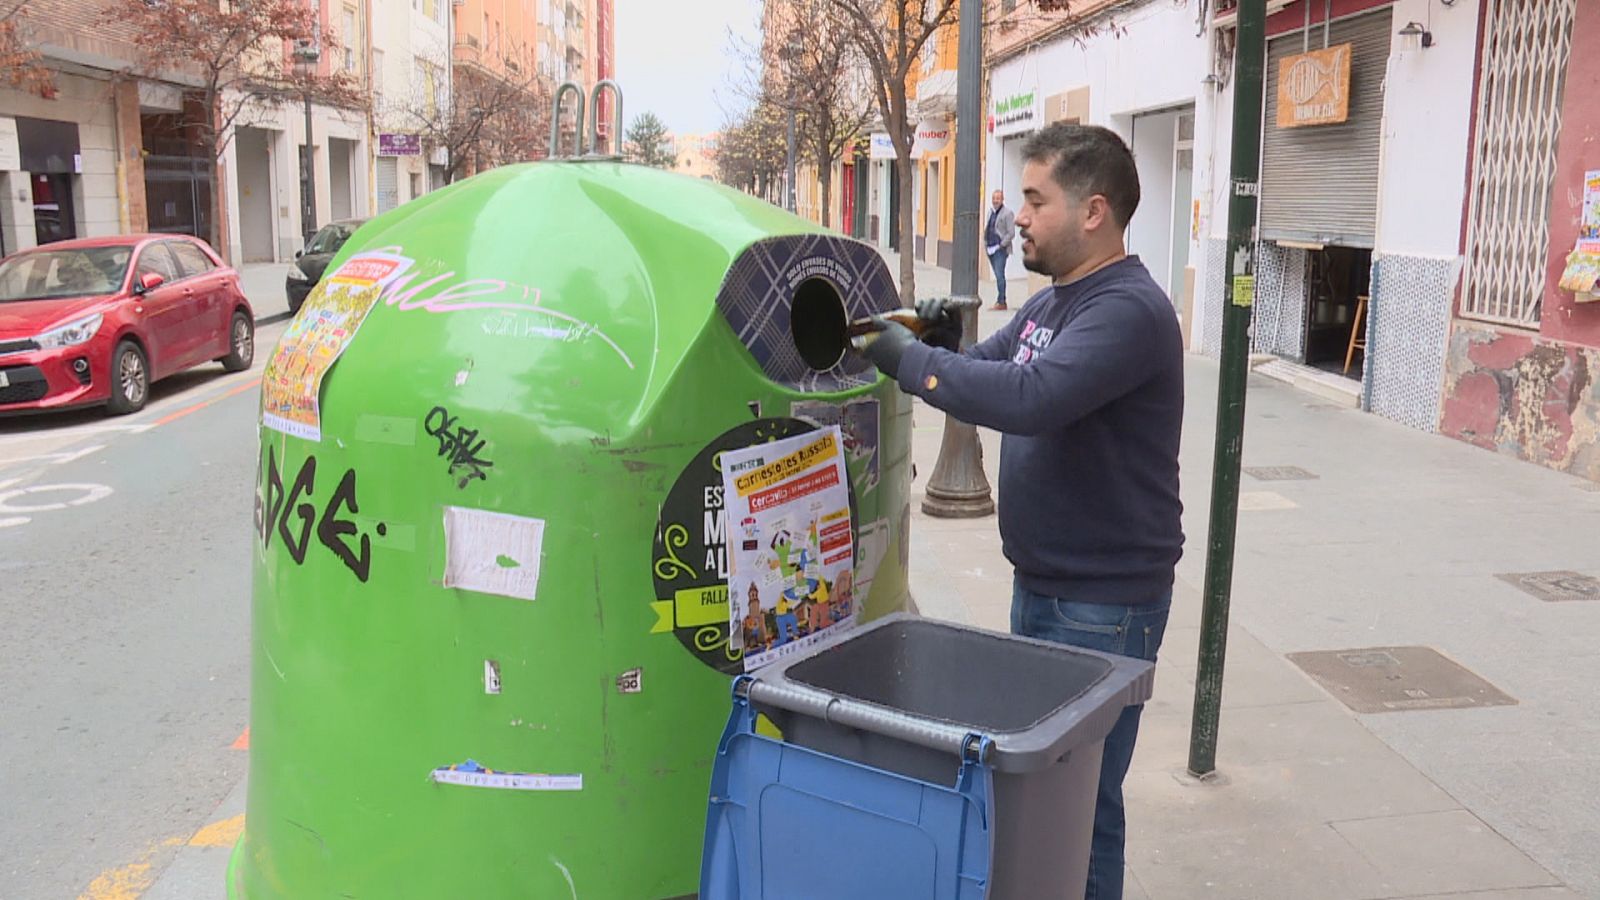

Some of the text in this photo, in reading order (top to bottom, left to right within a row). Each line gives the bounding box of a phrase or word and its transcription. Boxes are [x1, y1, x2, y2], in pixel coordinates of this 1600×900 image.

[918, 131, 947, 139] nube7
[801, 256, 826, 269] ENVASES
[827, 258, 835, 269] DE
[835, 262, 852, 284] VIDRIO
[806, 265, 829, 276] ENVASOS
[829, 269, 837, 278] DE
[799, 436, 833, 461] Russafa
[704, 485, 725, 508] ES
